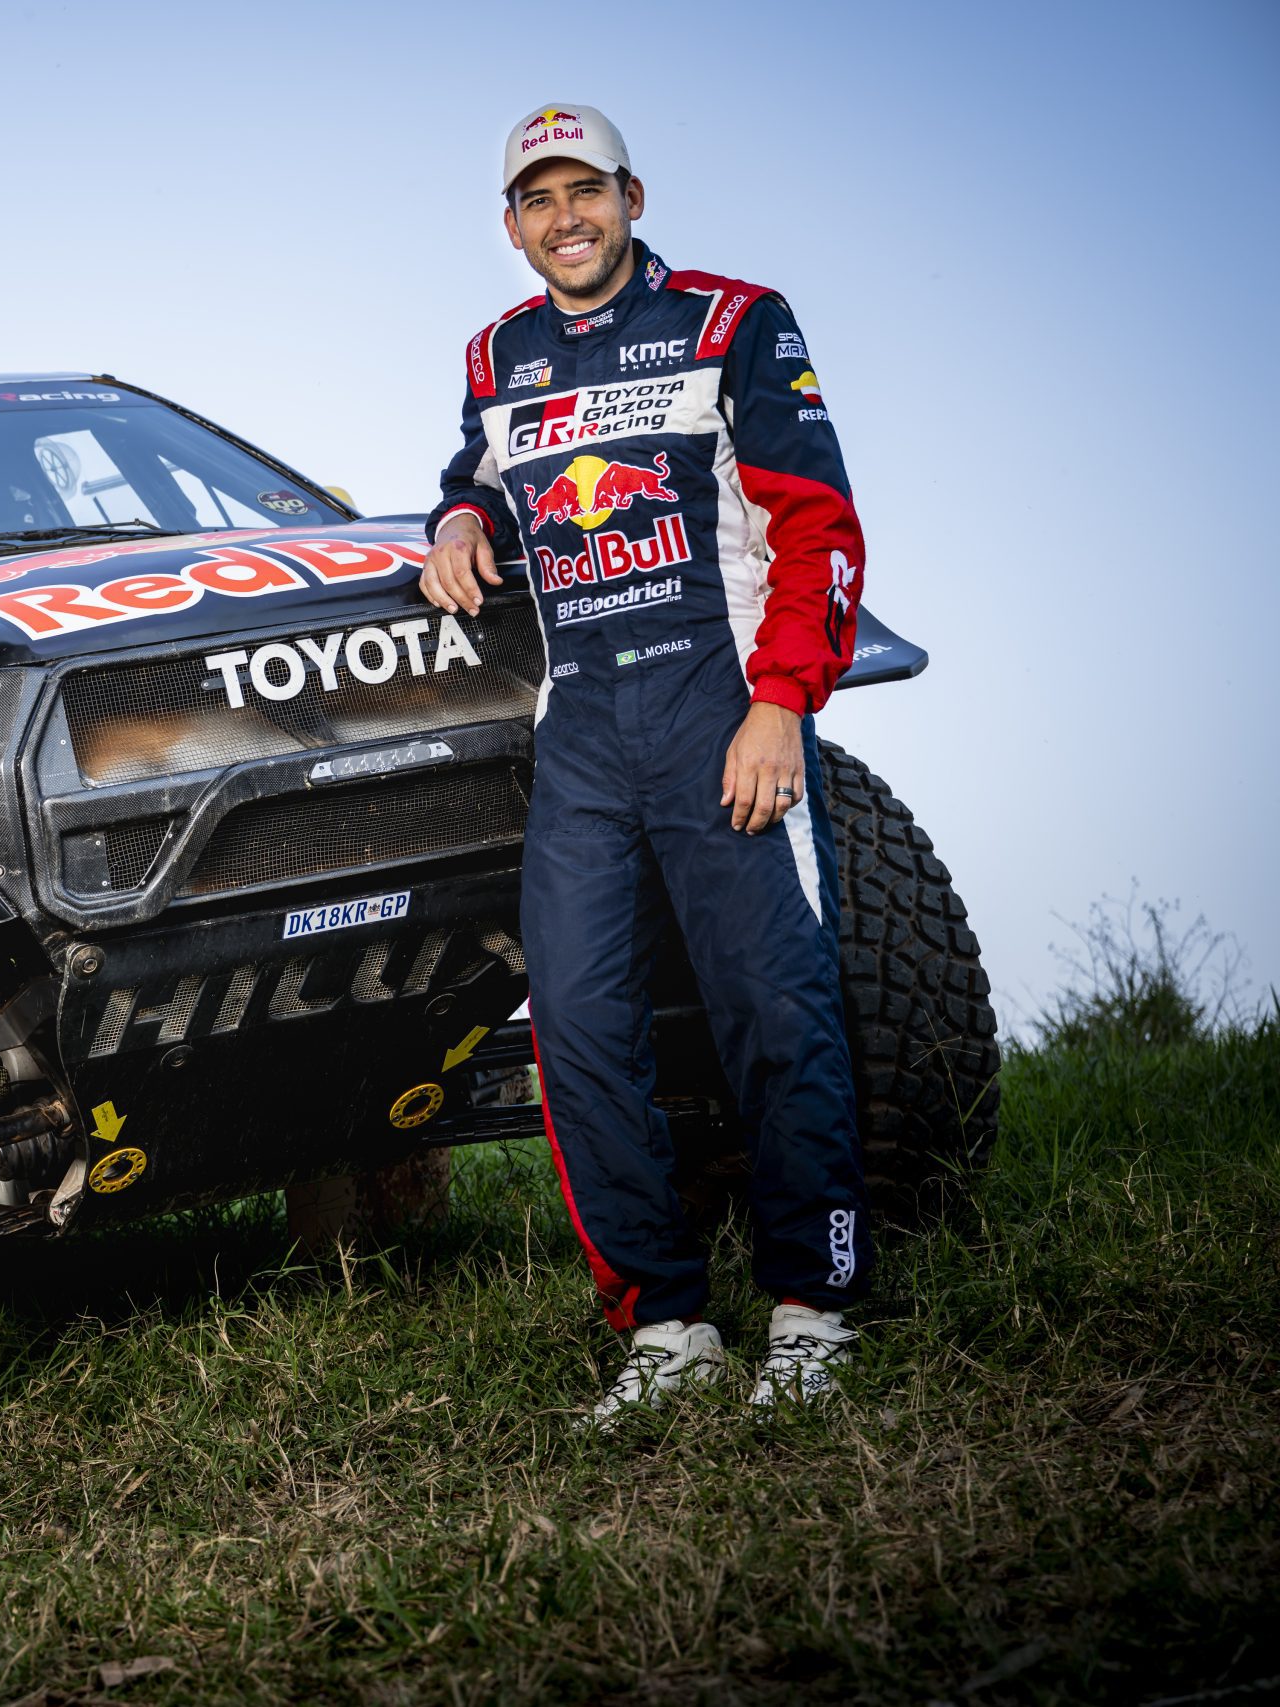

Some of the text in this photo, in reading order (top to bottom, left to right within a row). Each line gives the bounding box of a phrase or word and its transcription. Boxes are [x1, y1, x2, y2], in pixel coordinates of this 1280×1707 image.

[521, 127, 584, 153] Red Bull
[710, 294, 748, 344] sparco
[777, 332, 802, 344] SPE
[470, 331, 485, 385] sparco
[514, 358, 548, 373] SPEED
[509, 370, 542, 388] MAX
[587, 379, 685, 405] TOYOTA
[581, 399, 673, 423] GAZOO
[509, 415, 576, 456] GR
[578, 414, 667, 440] Racing
[534, 512, 692, 593] Red Bull
[556, 576, 682, 621] BFGoodrich
[204, 615, 482, 710] TOYOTA
[636, 639, 692, 660] L.MORAES
[551, 662, 580, 678] sparco
[287, 893, 408, 937] DK18KR GP
[825, 1208, 856, 1288] parco
